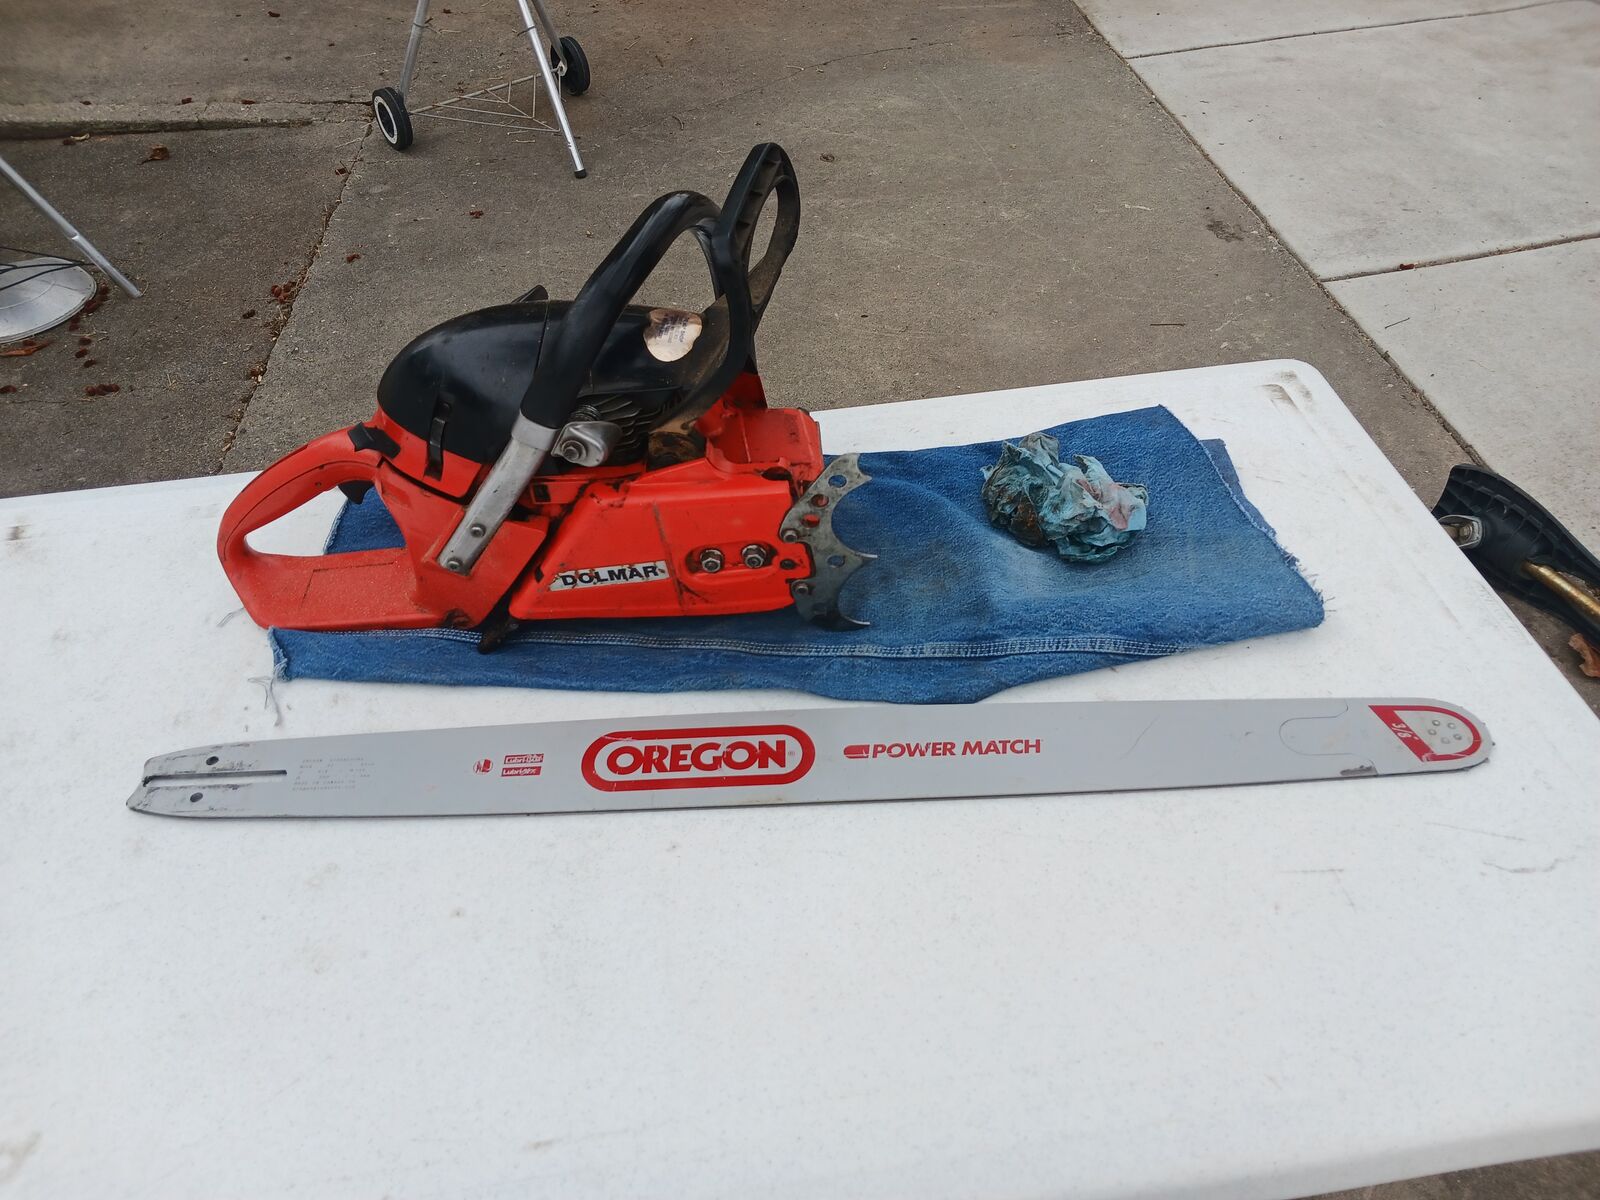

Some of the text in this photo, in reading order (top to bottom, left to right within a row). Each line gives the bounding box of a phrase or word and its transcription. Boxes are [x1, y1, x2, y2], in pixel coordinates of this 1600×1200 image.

[560, 565, 659, 586] DOLMAR
[606, 739, 786, 776] OREGON
[872, 739, 1041, 758] POWER MATCH
